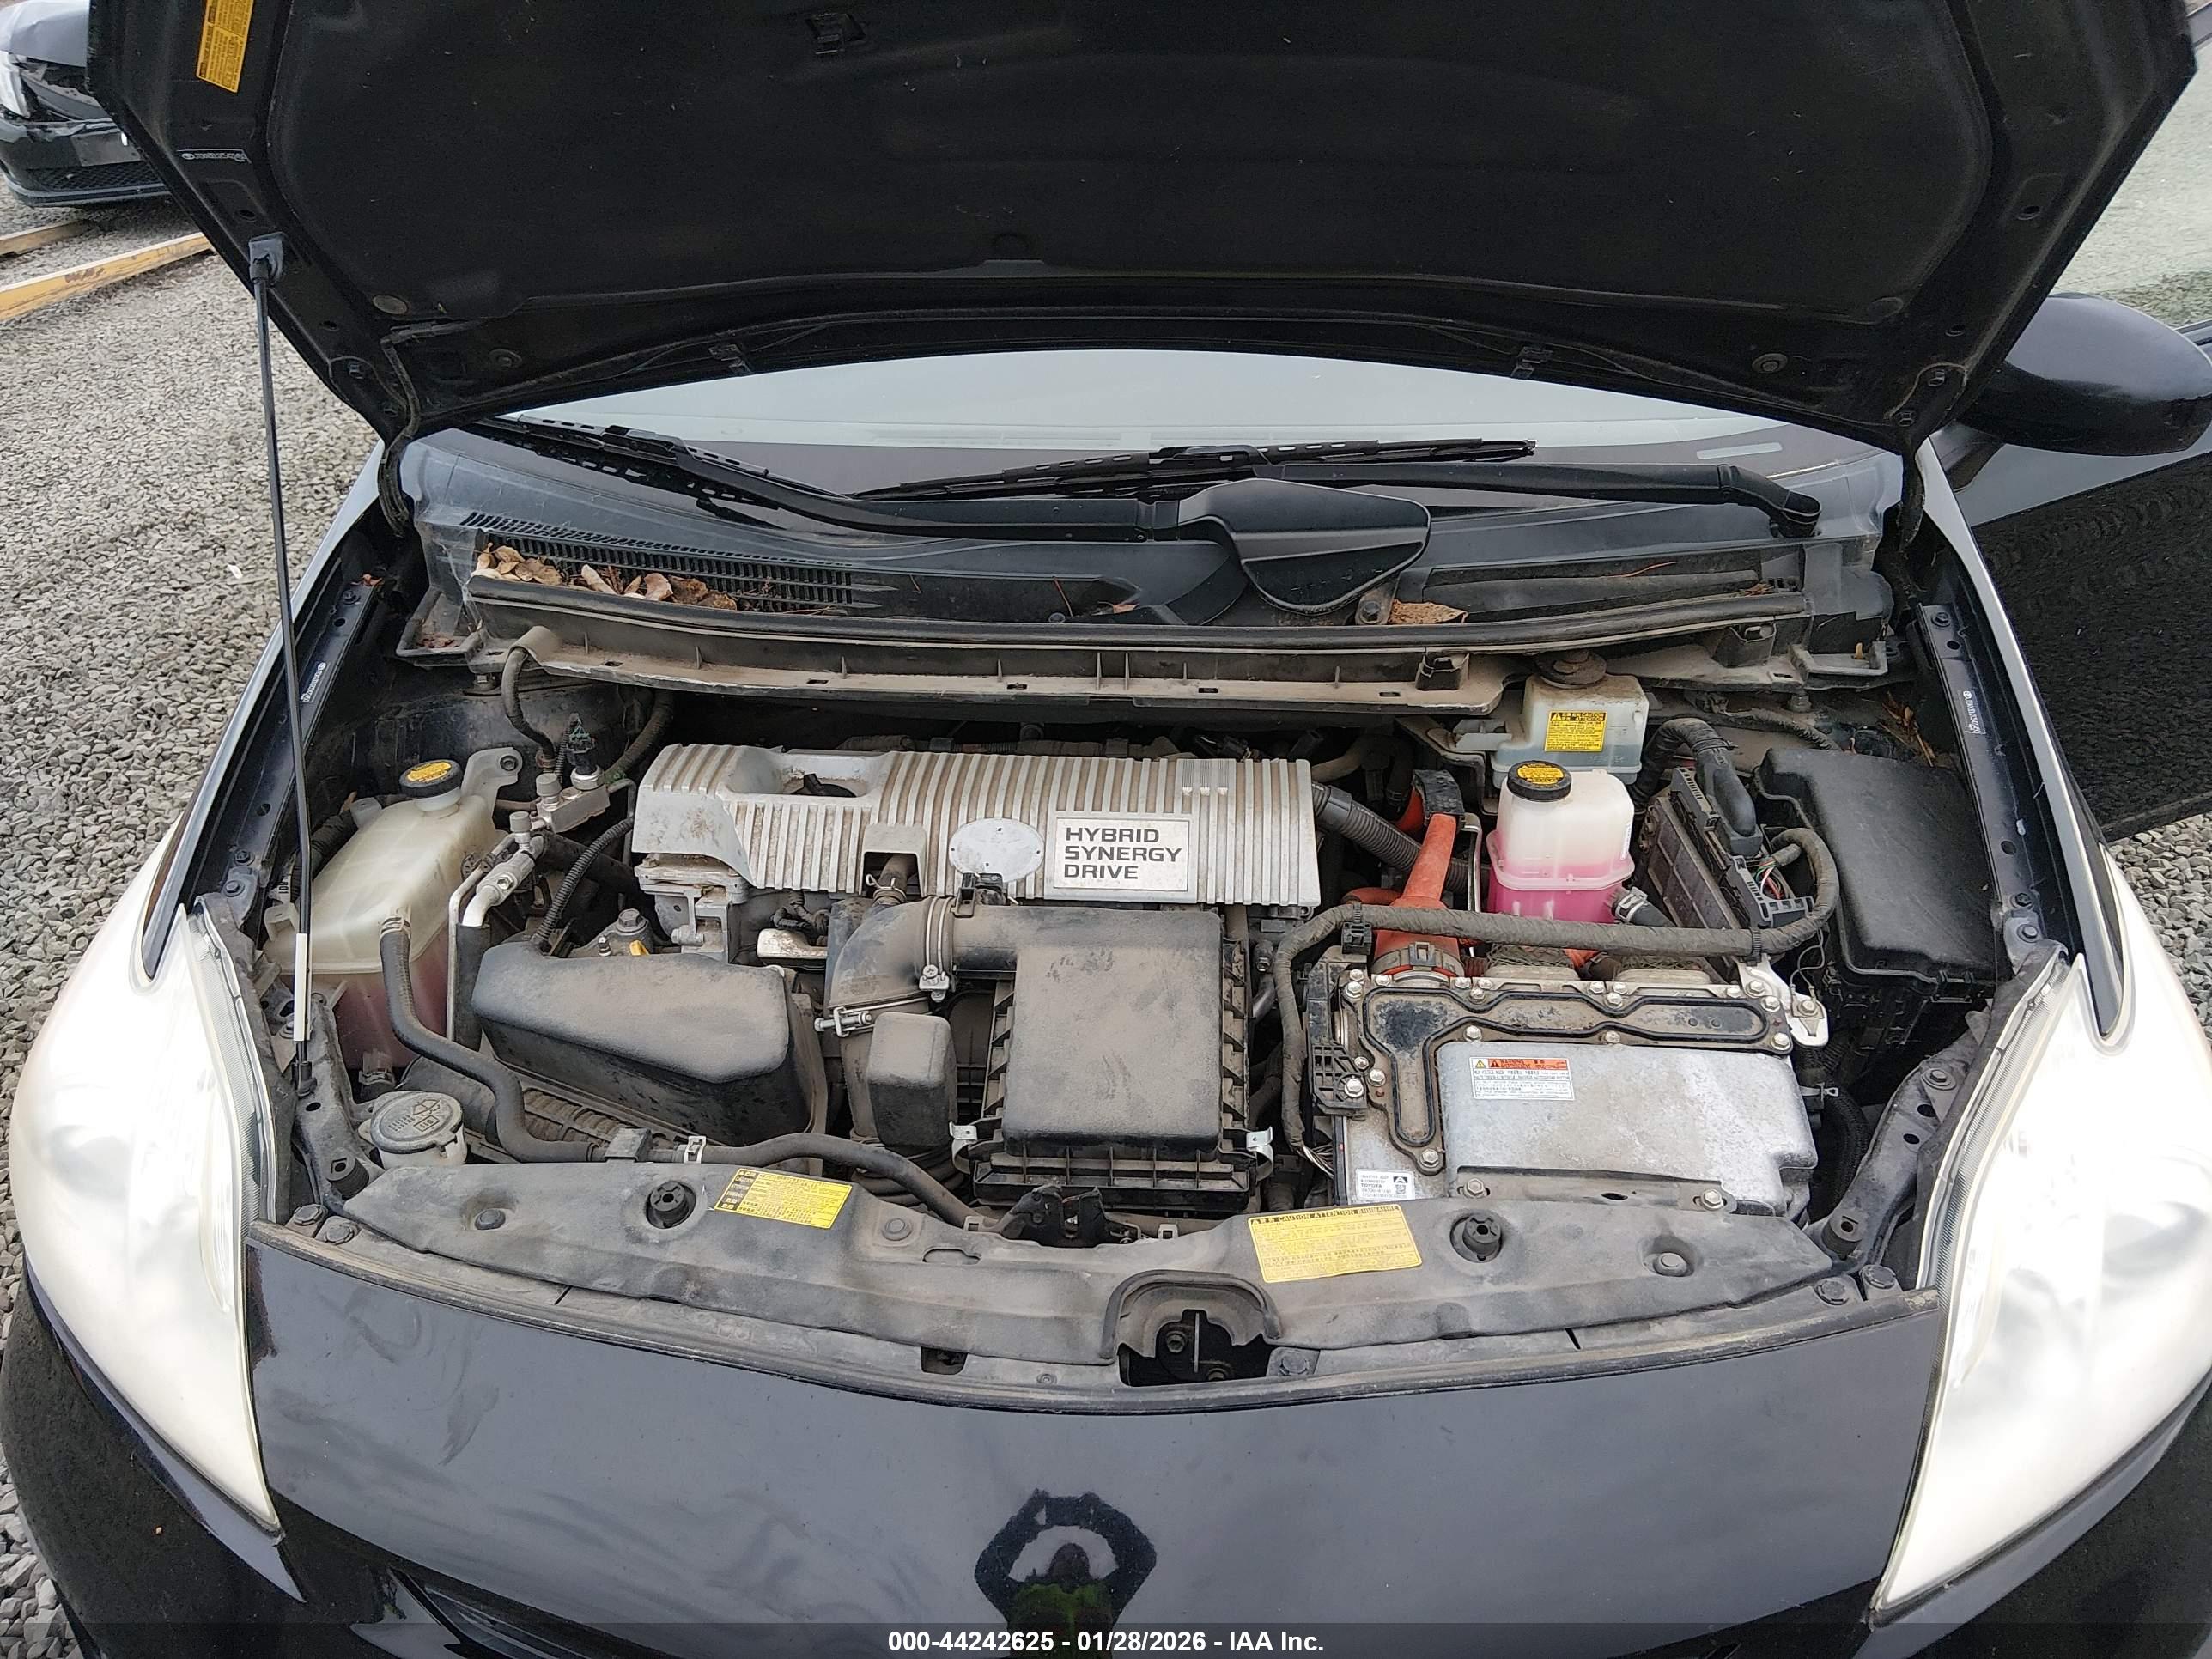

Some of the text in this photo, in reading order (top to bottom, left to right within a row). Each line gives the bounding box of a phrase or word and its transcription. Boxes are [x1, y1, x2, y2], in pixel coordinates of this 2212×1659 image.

[1066, 827, 1159, 842] HYBRID
[1065, 845, 1182, 862] SYNERGY
[1064, 864, 1139, 879] DRIVE
[1278, 1213, 1310, 1223] CAUTION
[1315, 1209, 1355, 1218] ATTENTION
